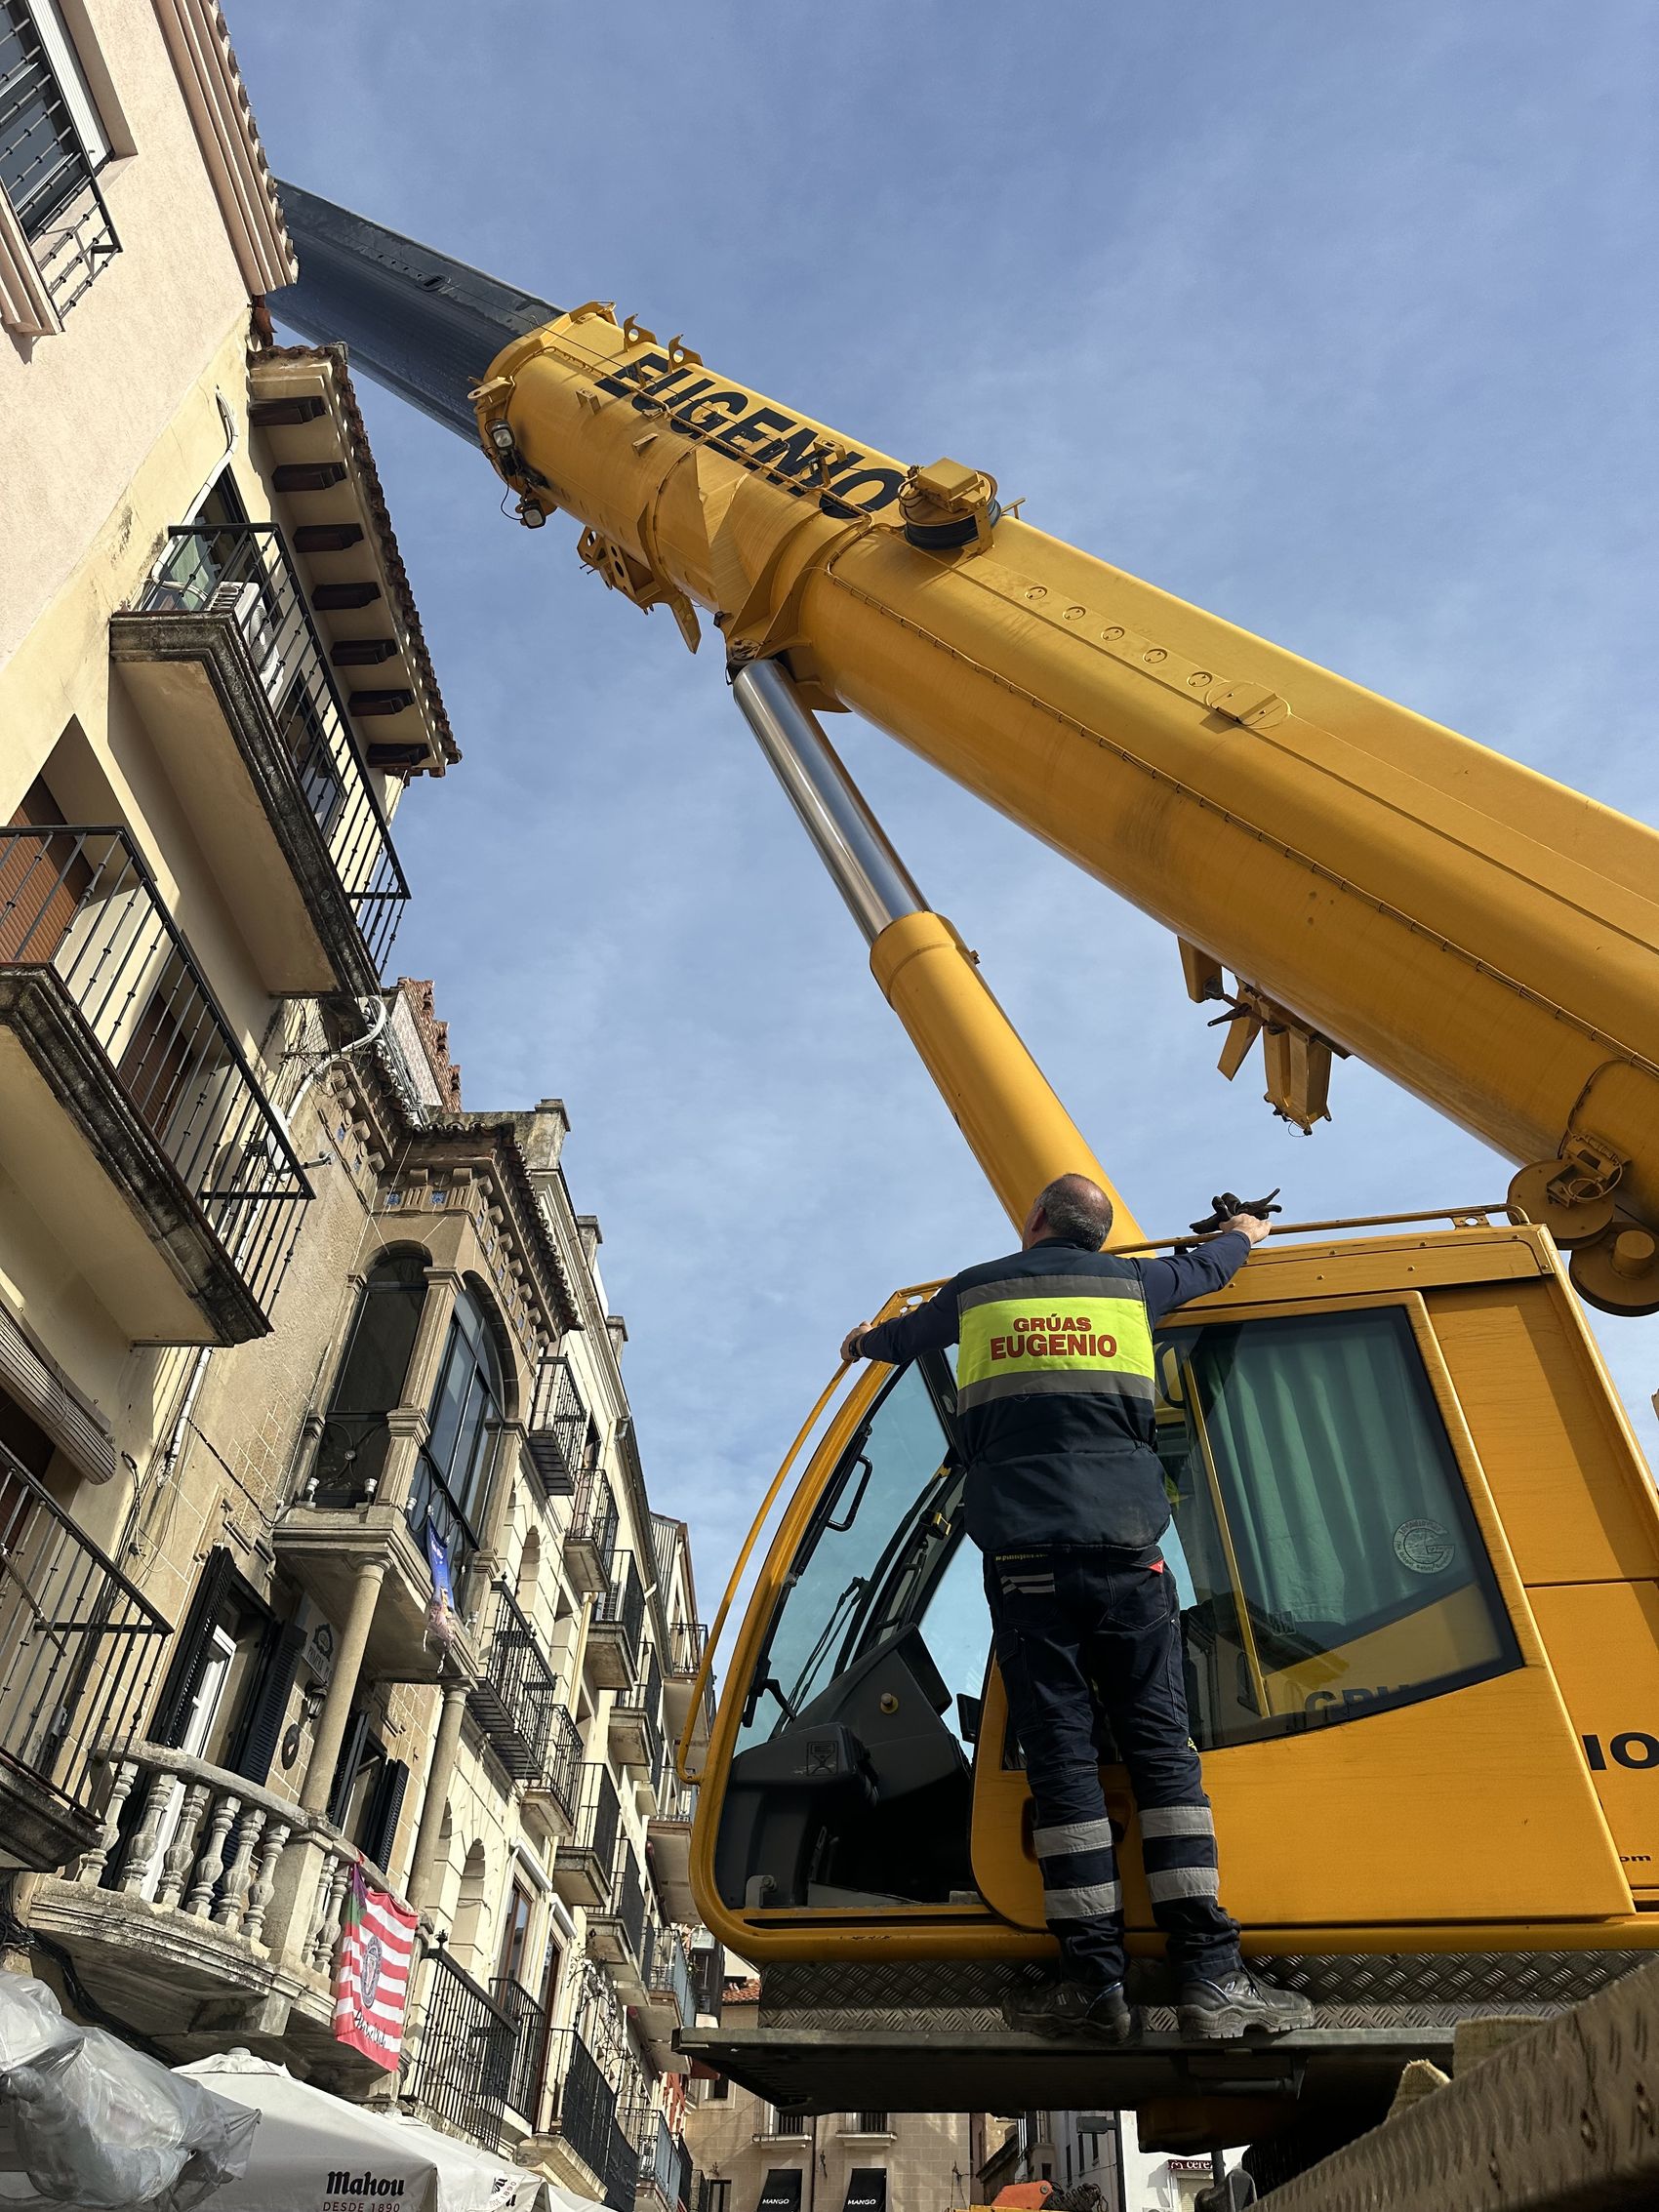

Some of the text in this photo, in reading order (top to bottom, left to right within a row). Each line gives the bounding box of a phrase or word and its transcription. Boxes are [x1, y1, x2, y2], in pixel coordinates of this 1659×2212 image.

[593, 352, 906, 519] EUGENIO
[1013, 1313, 1092, 1332] GRÚAS
[991, 1334, 1117, 1360] EUGENIO
[1187, 2160, 1213, 2169] cere
[326, 2171, 405, 2196] Mahou
[323, 2202, 400, 2212] DESDE 1890
